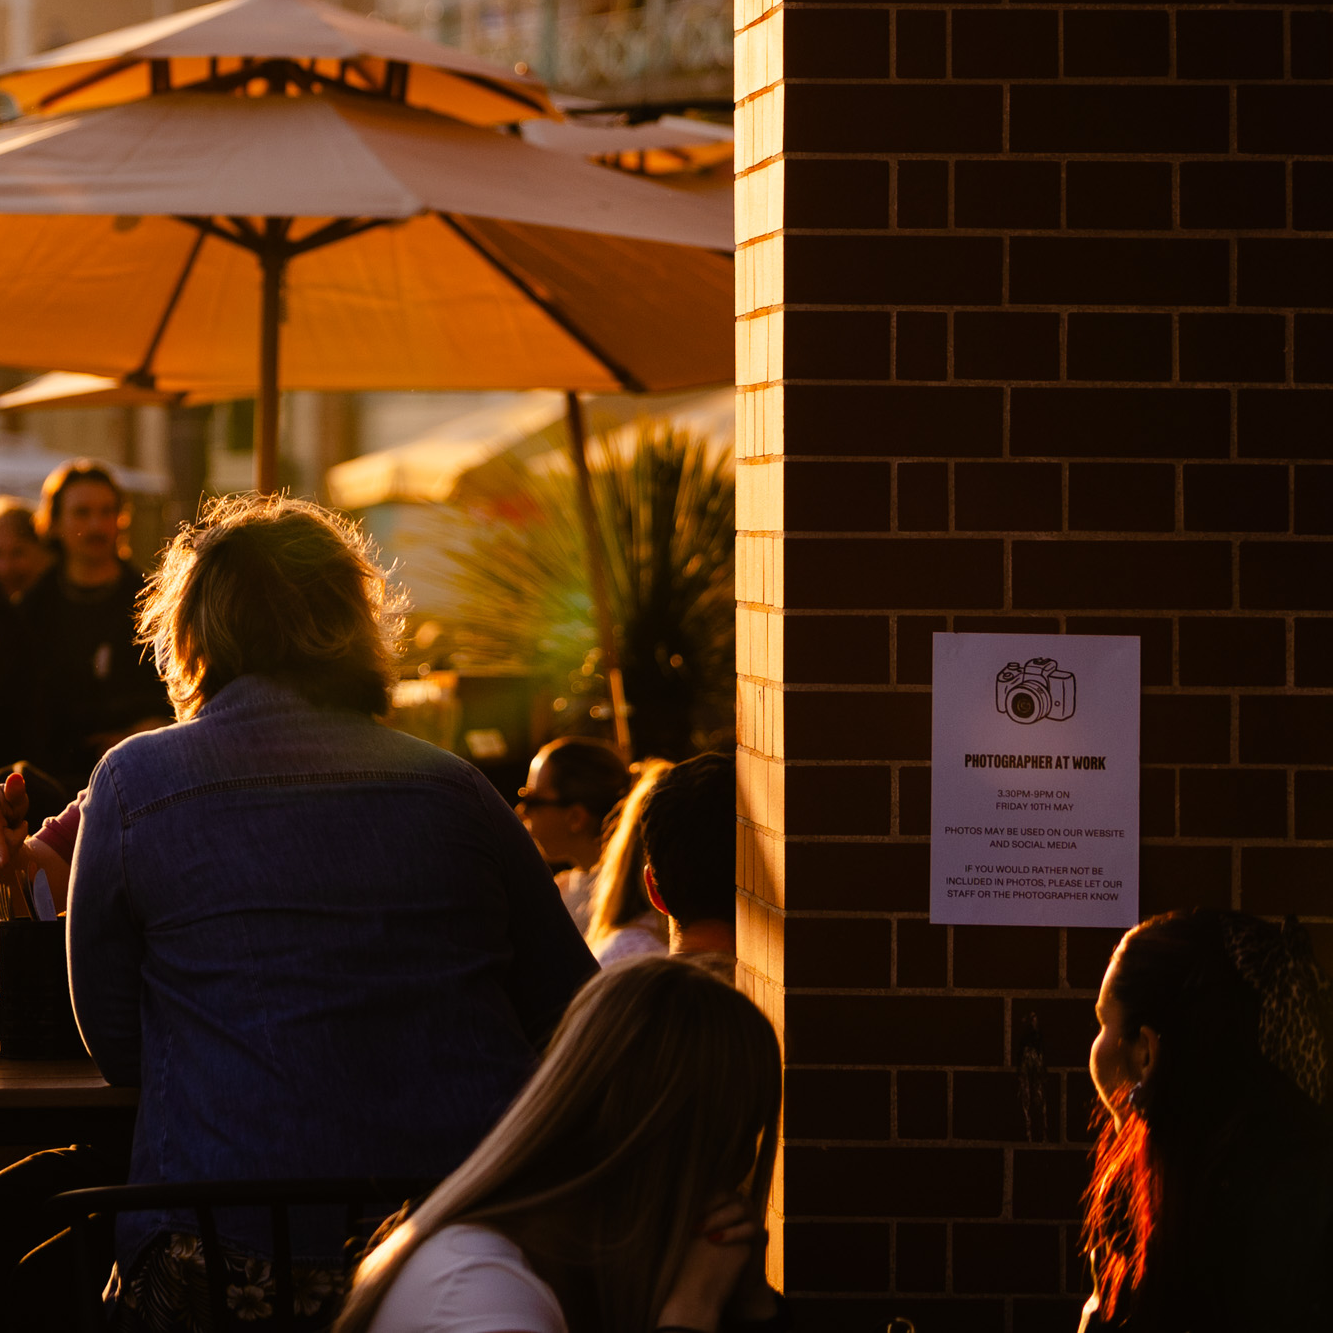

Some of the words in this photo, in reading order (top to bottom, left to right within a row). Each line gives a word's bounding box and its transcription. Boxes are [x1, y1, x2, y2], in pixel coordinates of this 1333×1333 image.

[964, 754, 1053, 770] PHOTOGRAPHER
[1055, 756, 1071, 769] AT
[1072, 756, 1106, 770] WORK
[997, 789, 1054, 798] 3.30PM-9PM
[1055, 790, 1070, 799] ON
[995, 802, 1028, 811] FRIDAY
[1029, 803, 1052, 811] 10TH
[1053, 803, 1074, 811] MAY
[944, 826, 983, 836] PHOTOS
[984, 827, 1005, 836] MAY
[1006, 827, 1019, 836] BE
[1020, 827, 1045, 837] USED
[1046, 828, 1061, 837] ON
[1063, 828, 1083, 837] OUR
[1084, 829, 1125, 838] WEBSITE
[989, 840, 1010, 849] AND
[1012, 840, 1045, 849] SOCIAL
[1047, 841, 1077, 850] MEDIA
[964, 865, 973, 873] IF
[974, 865, 994, 873] YOU
[995, 865, 1030, 874] WOULD
[1031, 866, 1068, 875] RATHER
[1070, 866, 1090, 875] NOT
[1091, 867, 1104, 875] BE
[945, 877, 993, 886] INCLUDED
[994, 878, 1004, 886] IN
[1006, 878, 1046, 888] PHOTOS,
[1047, 879, 1083, 888] PLEASE
[1084, 880, 1102, 888] LET
[1102, 880, 1123, 889] OUR
[947, 889, 976, 898] STAFF
[977, 890, 991, 899] OR
[992, 890, 1011, 899] THE
[1012, 891, 1089, 900] PHOTOGRAPHER
[1090, 892, 1119, 901] KNOW
